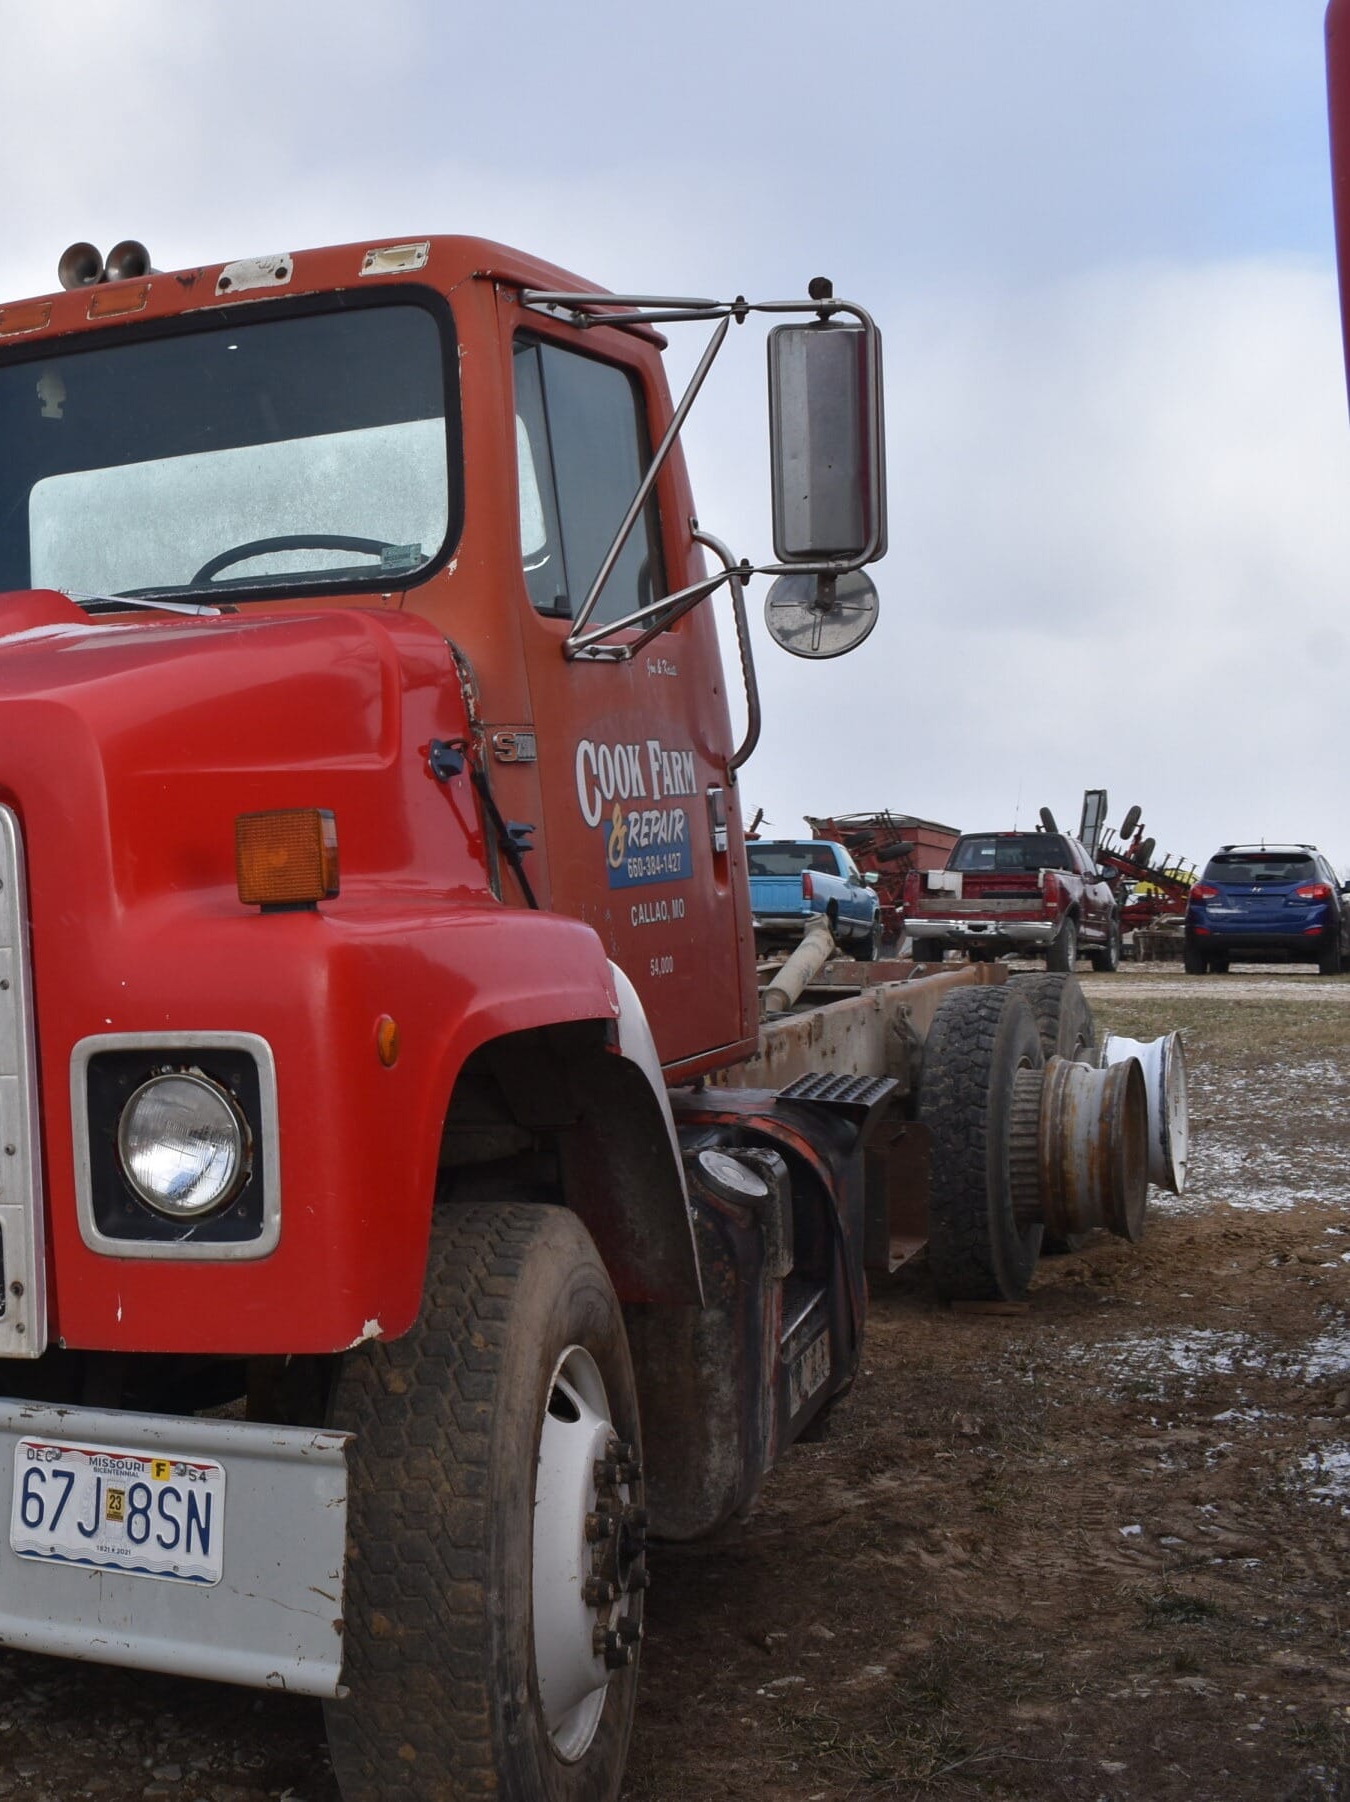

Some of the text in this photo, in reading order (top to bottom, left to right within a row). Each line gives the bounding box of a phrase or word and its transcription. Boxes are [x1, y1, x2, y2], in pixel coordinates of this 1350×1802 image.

[576, 739, 698, 828] COOK FARM
[607, 803, 684, 869] & REPAIR
[627, 852, 682, 879] 660-384-1427
[631, 898, 685, 928] CALLAO, MO
[650, 955, 674, 977] 54,000
[27, 1448, 207, 1483] DEC MISSOURI F 54
[93, 1467, 140, 1478] BICENTENNIAL
[21, 1466, 212, 1556] 67J 8SN
[109, 1494, 122, 1510] 23
